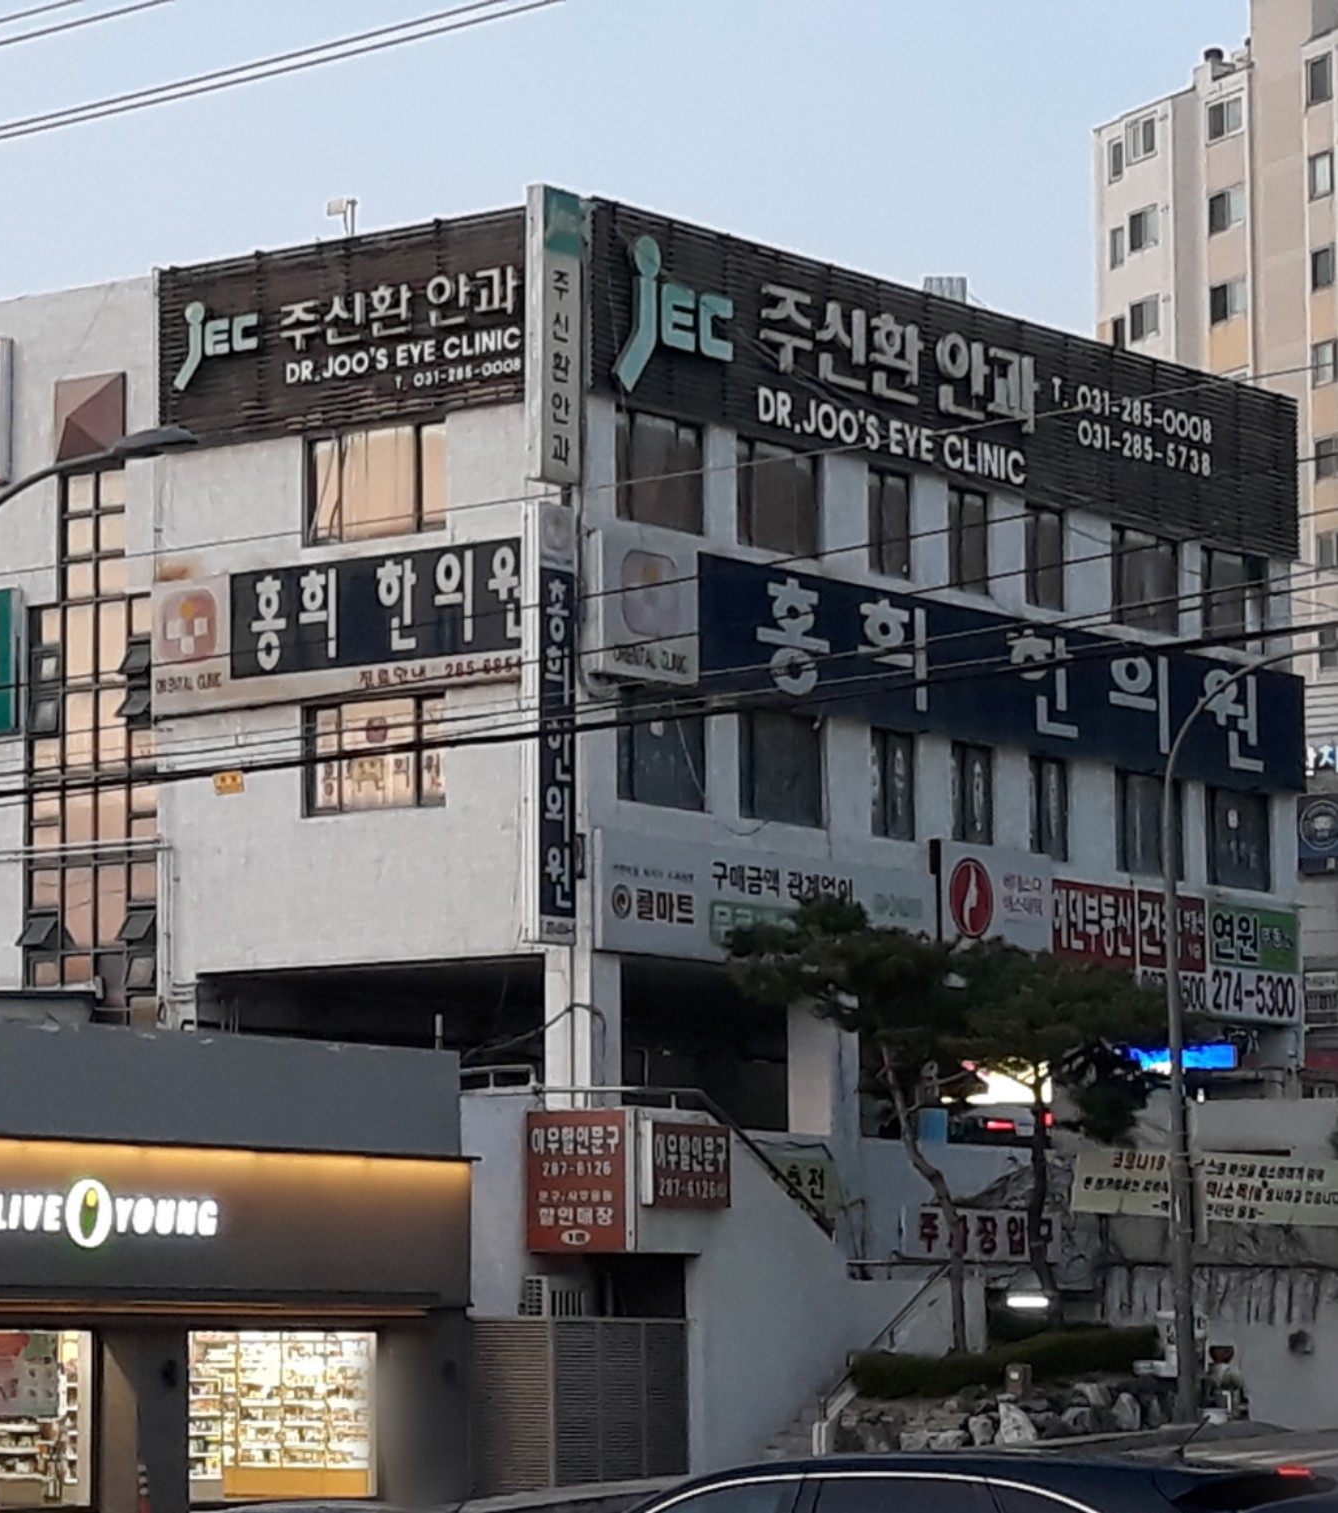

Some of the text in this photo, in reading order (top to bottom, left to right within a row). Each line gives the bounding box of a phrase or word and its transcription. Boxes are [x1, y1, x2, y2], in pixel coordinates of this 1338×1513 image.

[280, 265, 522, 351] 주신환 안과
[286, 326, 522, 384] DR.JOO'S EYE CLINIC
[759, 283, 1041, 433] 주신환 안과
[757, 387, 1027, 485] DR.JOO'S EYE CLINIC
[1077, 385, 1212, 444] 031-285-0008
[1078, 419, 1211, 477] 031-285-5738
[251, 546, 521, 672] 홍희 한의원
[756, 577, 1264, 773] 홍희 한의원
[712, 862, 780, 897] 구매금액
[1213, 912, 1259, 963] 연원
[1213, 969, 1296, 1018] 274-5300
[115, 1197, 219, 1236] YOUNG
